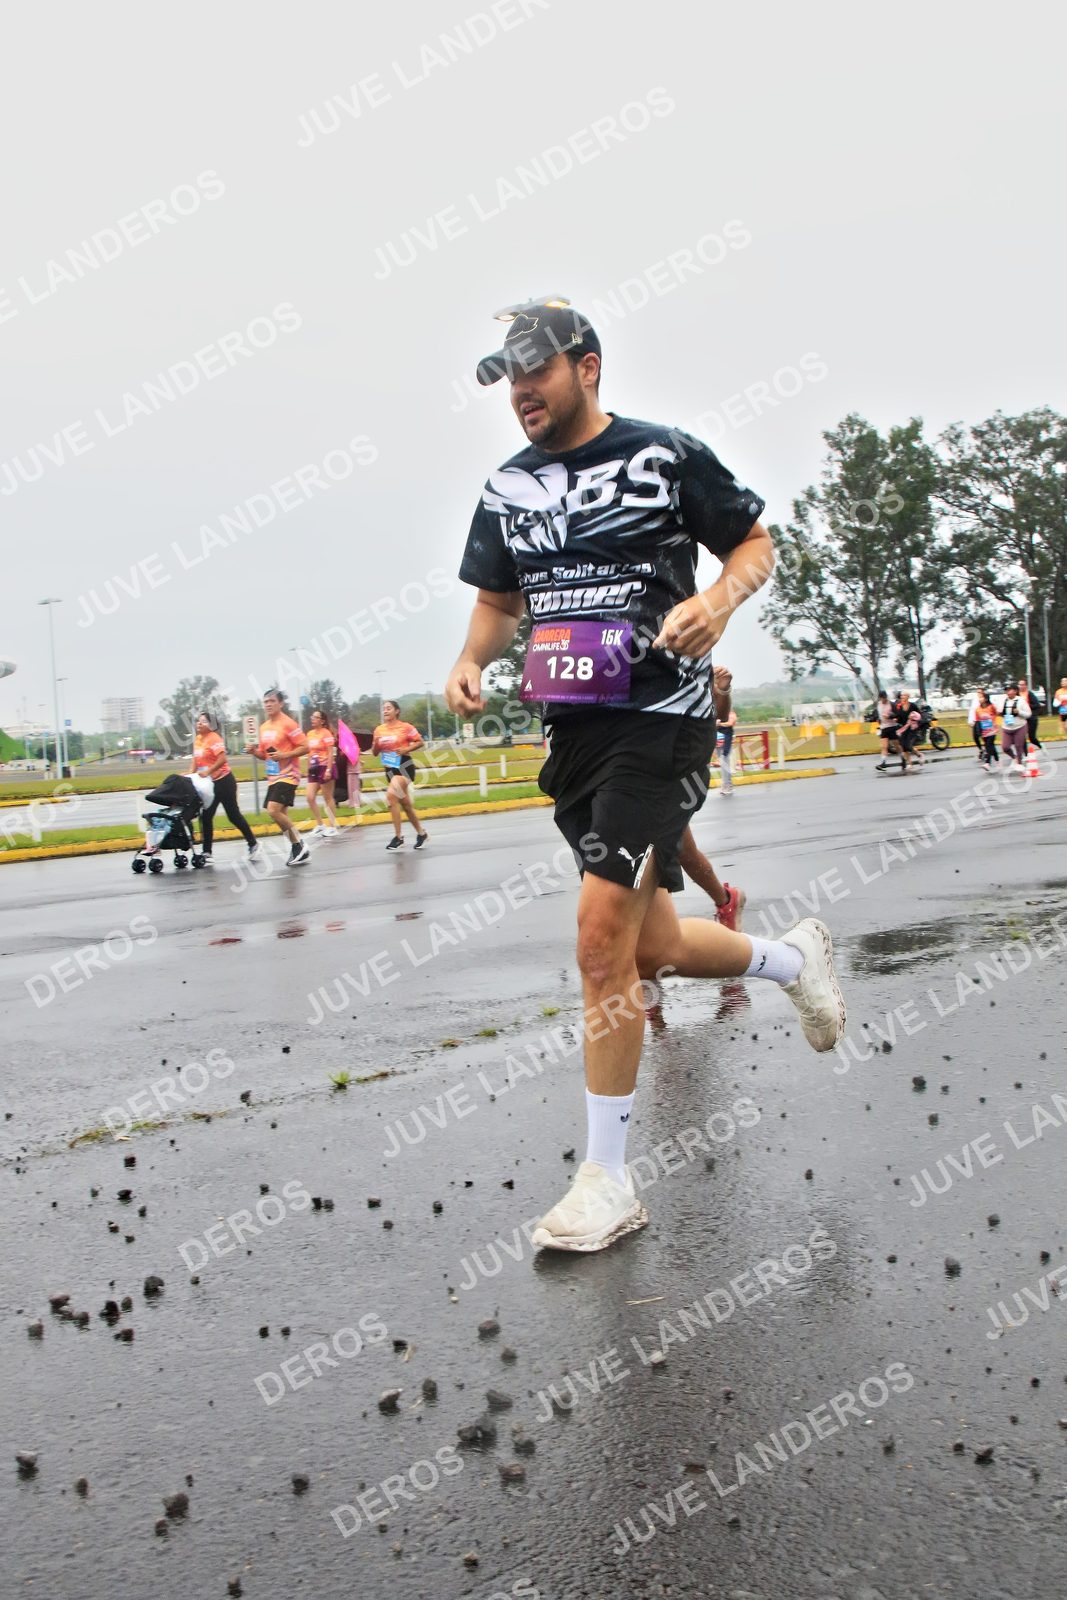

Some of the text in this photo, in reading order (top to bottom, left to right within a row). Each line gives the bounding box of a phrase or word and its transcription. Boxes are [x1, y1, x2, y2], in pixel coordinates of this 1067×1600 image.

[534, 627, 624, 645] CARRERA 16K
[532, 642, 560, 652] OMNILIFE
[546, 656, 594, 680] 128
